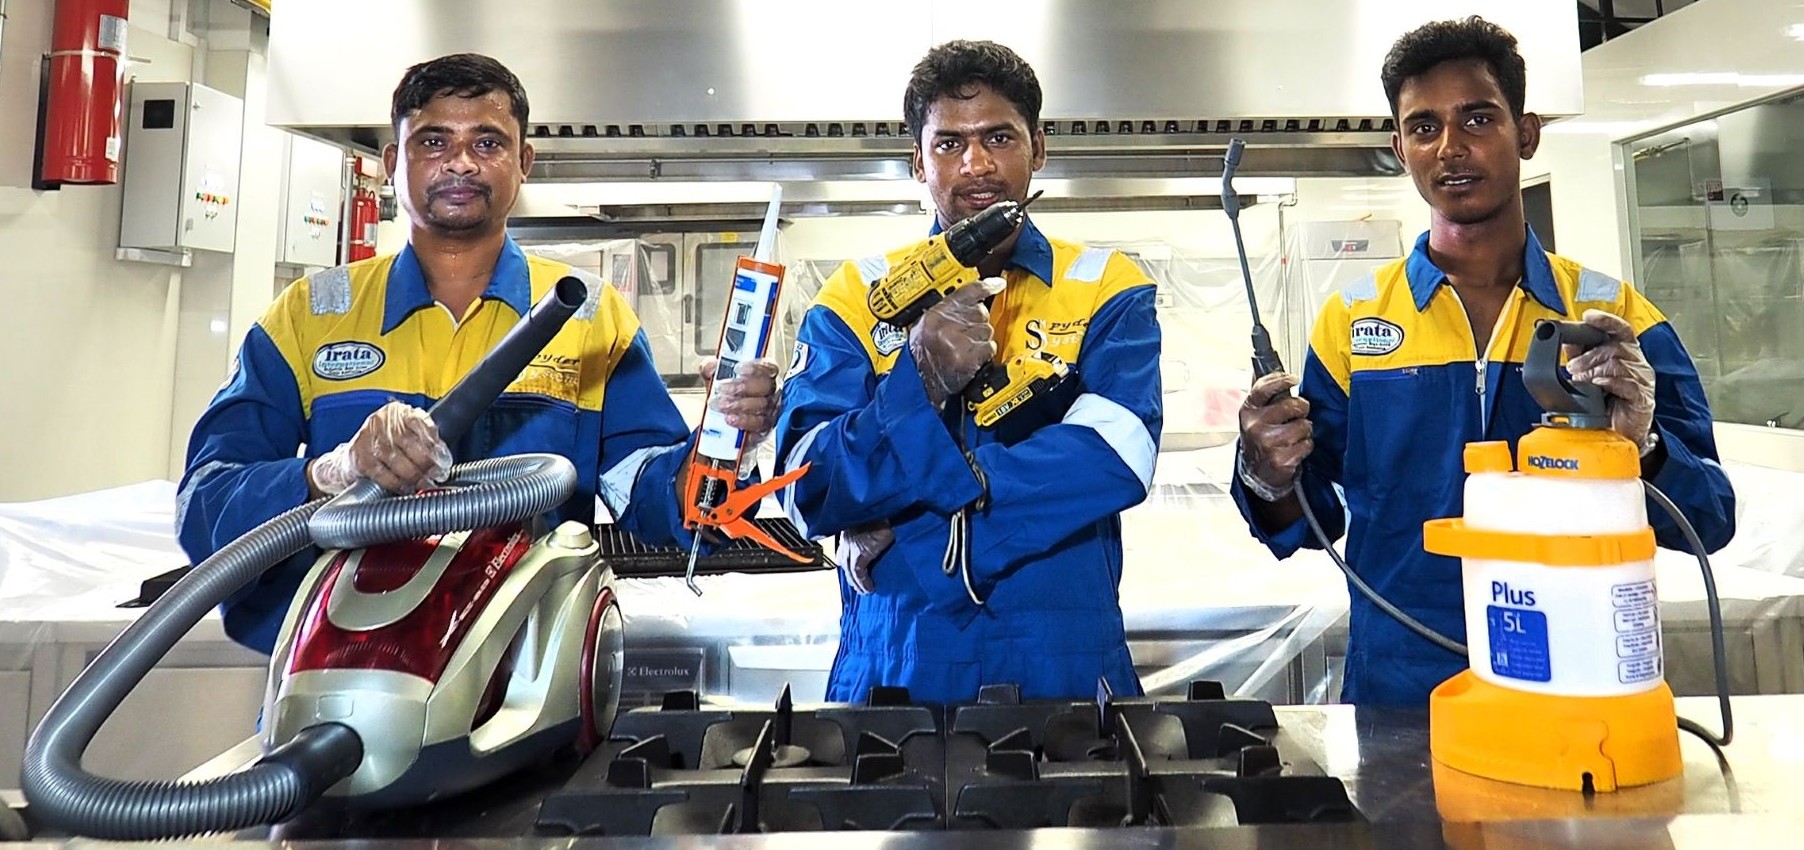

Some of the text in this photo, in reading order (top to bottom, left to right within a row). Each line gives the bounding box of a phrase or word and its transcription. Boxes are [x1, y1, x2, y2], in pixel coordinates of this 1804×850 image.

[1528, 455, 1579, 470] HOZELOCK
[1492, 580, 1536, 606] Plus
[1503, 611, 1527, 634] 5L
[639, 666, 689, 676] Electrolux
